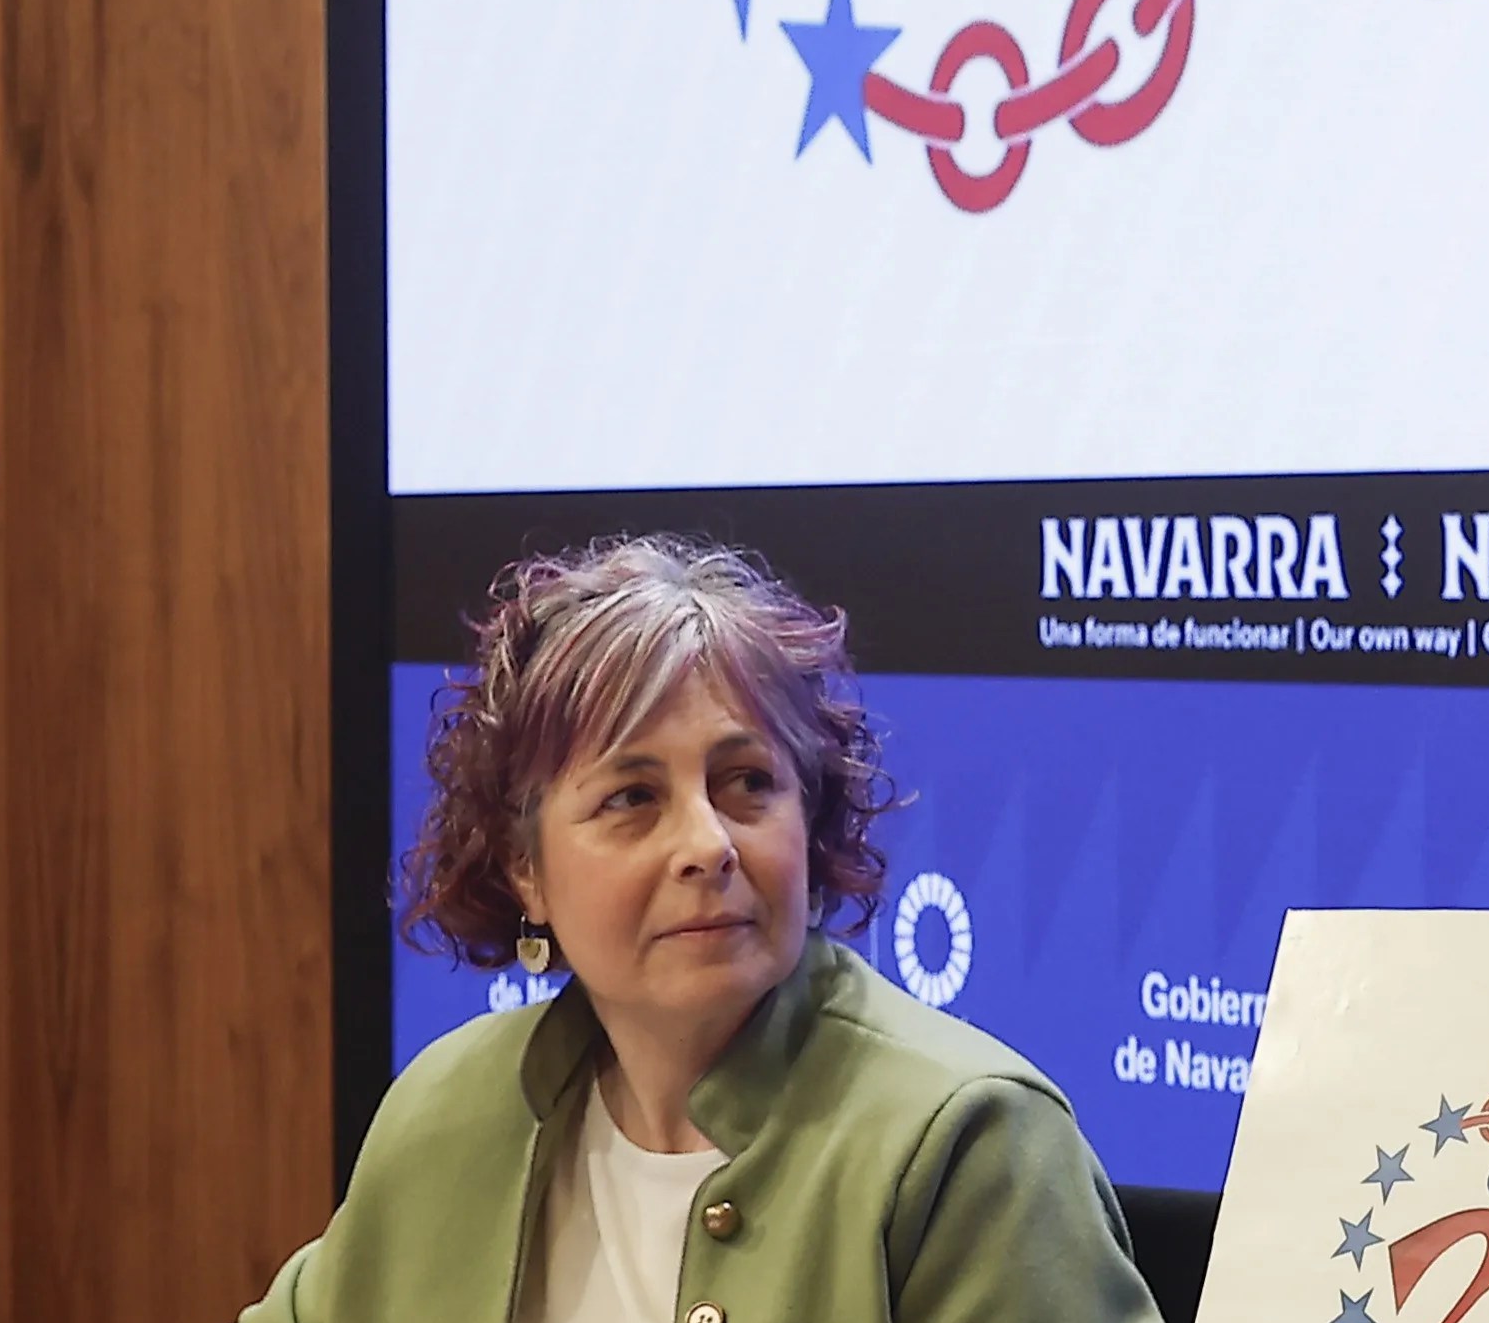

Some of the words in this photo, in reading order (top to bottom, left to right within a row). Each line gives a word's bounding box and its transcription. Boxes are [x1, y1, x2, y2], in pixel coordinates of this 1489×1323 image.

[1043, 516, 1347, 597] NAVARRA
[1041, 618, 1081, 645] Una
[1086, 619, 1147, 645] forma
[1153, 620, 1180, 646] de
[1185, 619, 1288, 647] funcionar
[1311, 619, 1353, 649] Our
[1359, 628, 1408, 649] own
[1415, 628, 1460, 656] way
[1115, 1036, 1156, 1083] de
[1164, 1039, 1253, 1095] Nava
